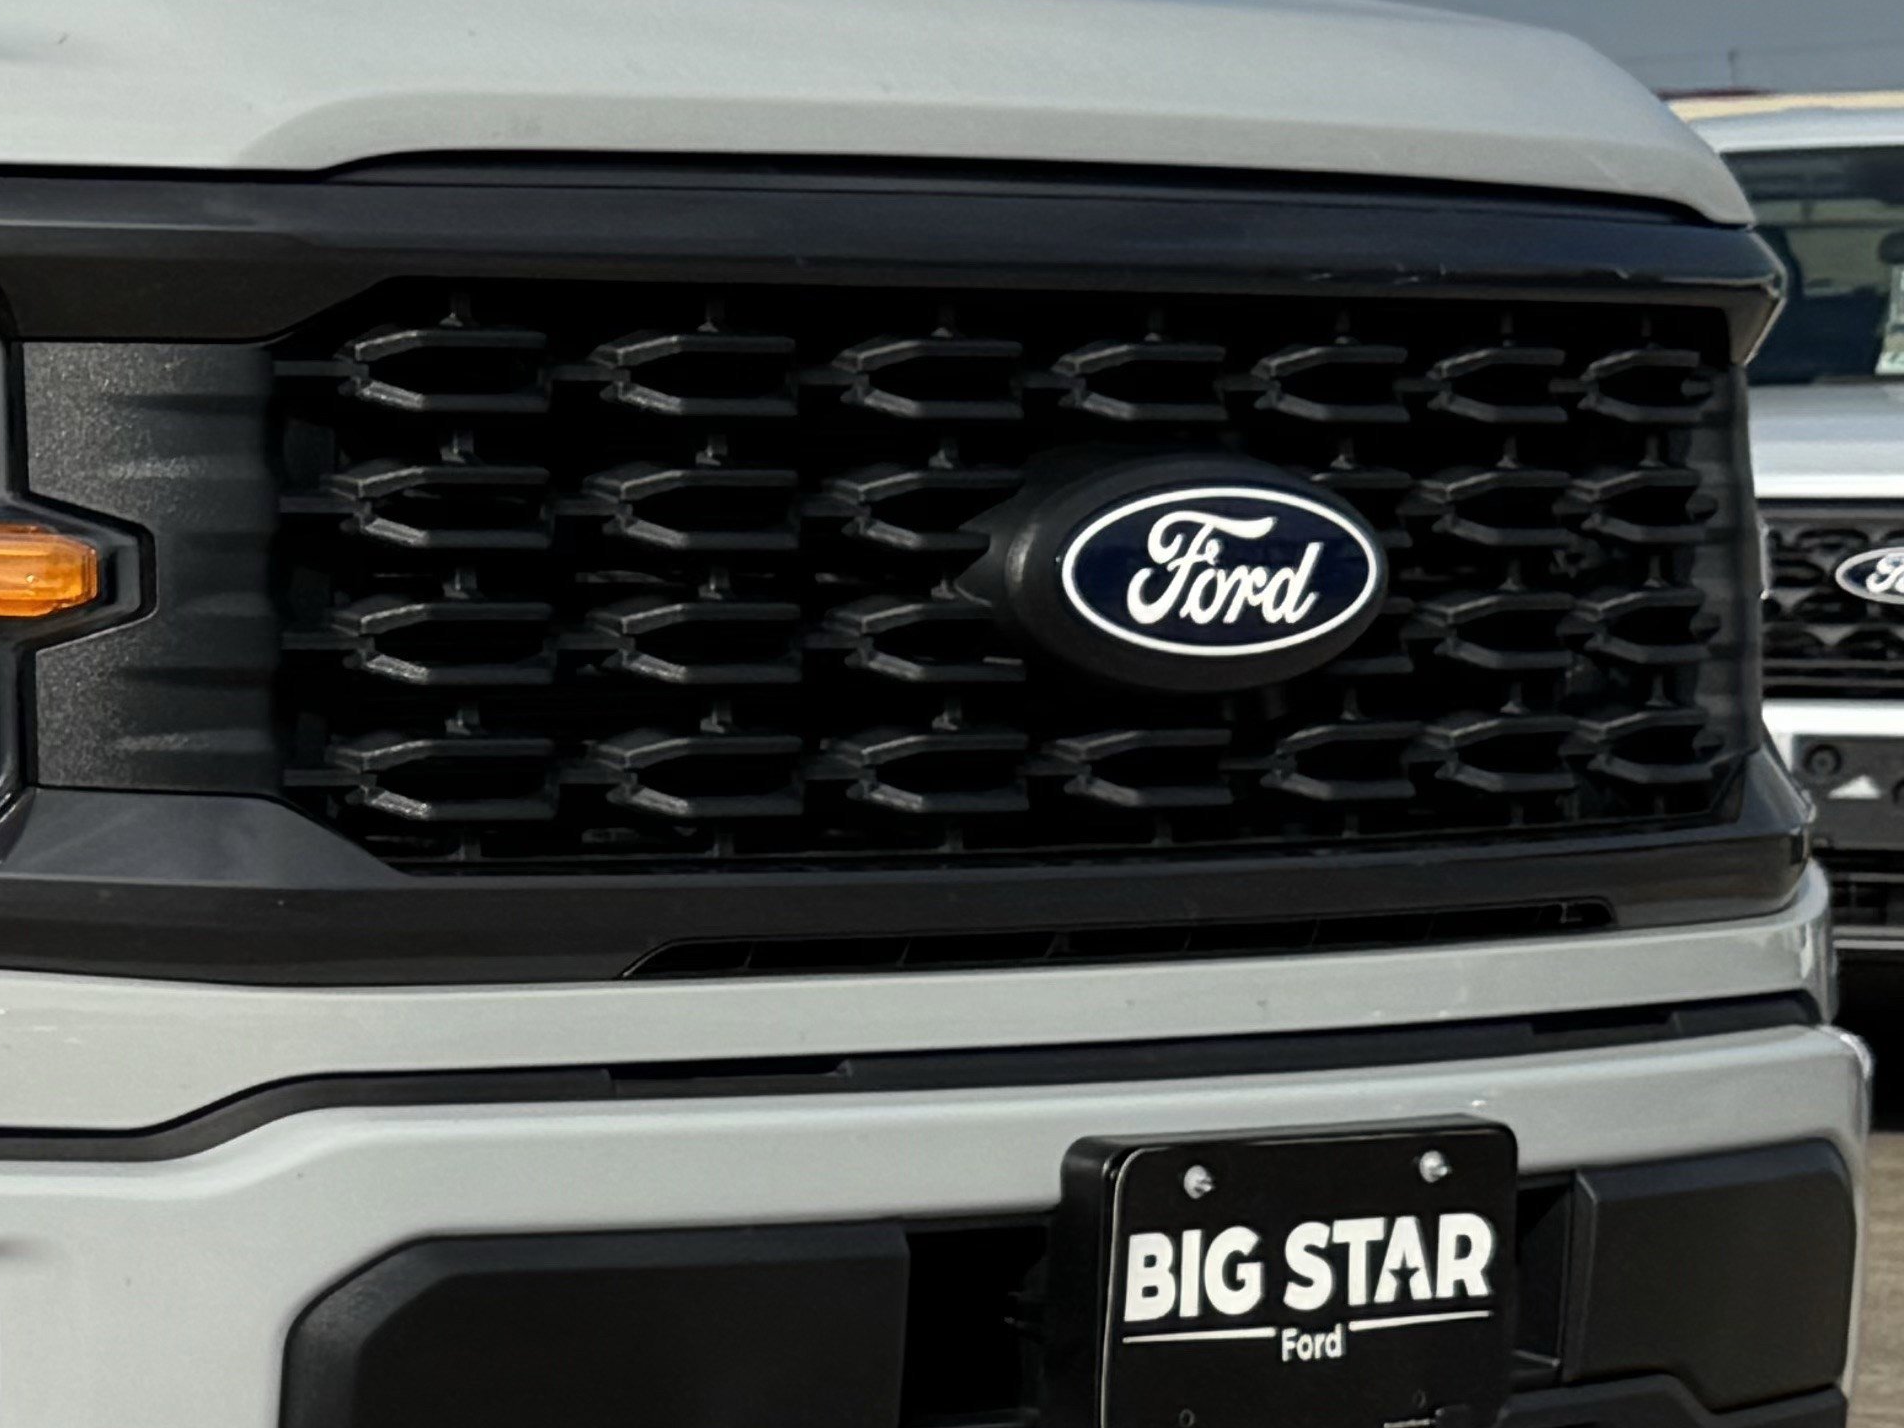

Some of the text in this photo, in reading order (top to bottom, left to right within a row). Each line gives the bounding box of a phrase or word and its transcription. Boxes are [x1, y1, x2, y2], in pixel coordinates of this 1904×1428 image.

[1125, 509, 1325, 626] Ford
[1122, 1211, 1498, 1323] BIG STAR
[1280, 1324, 1345, 1362] Ford
